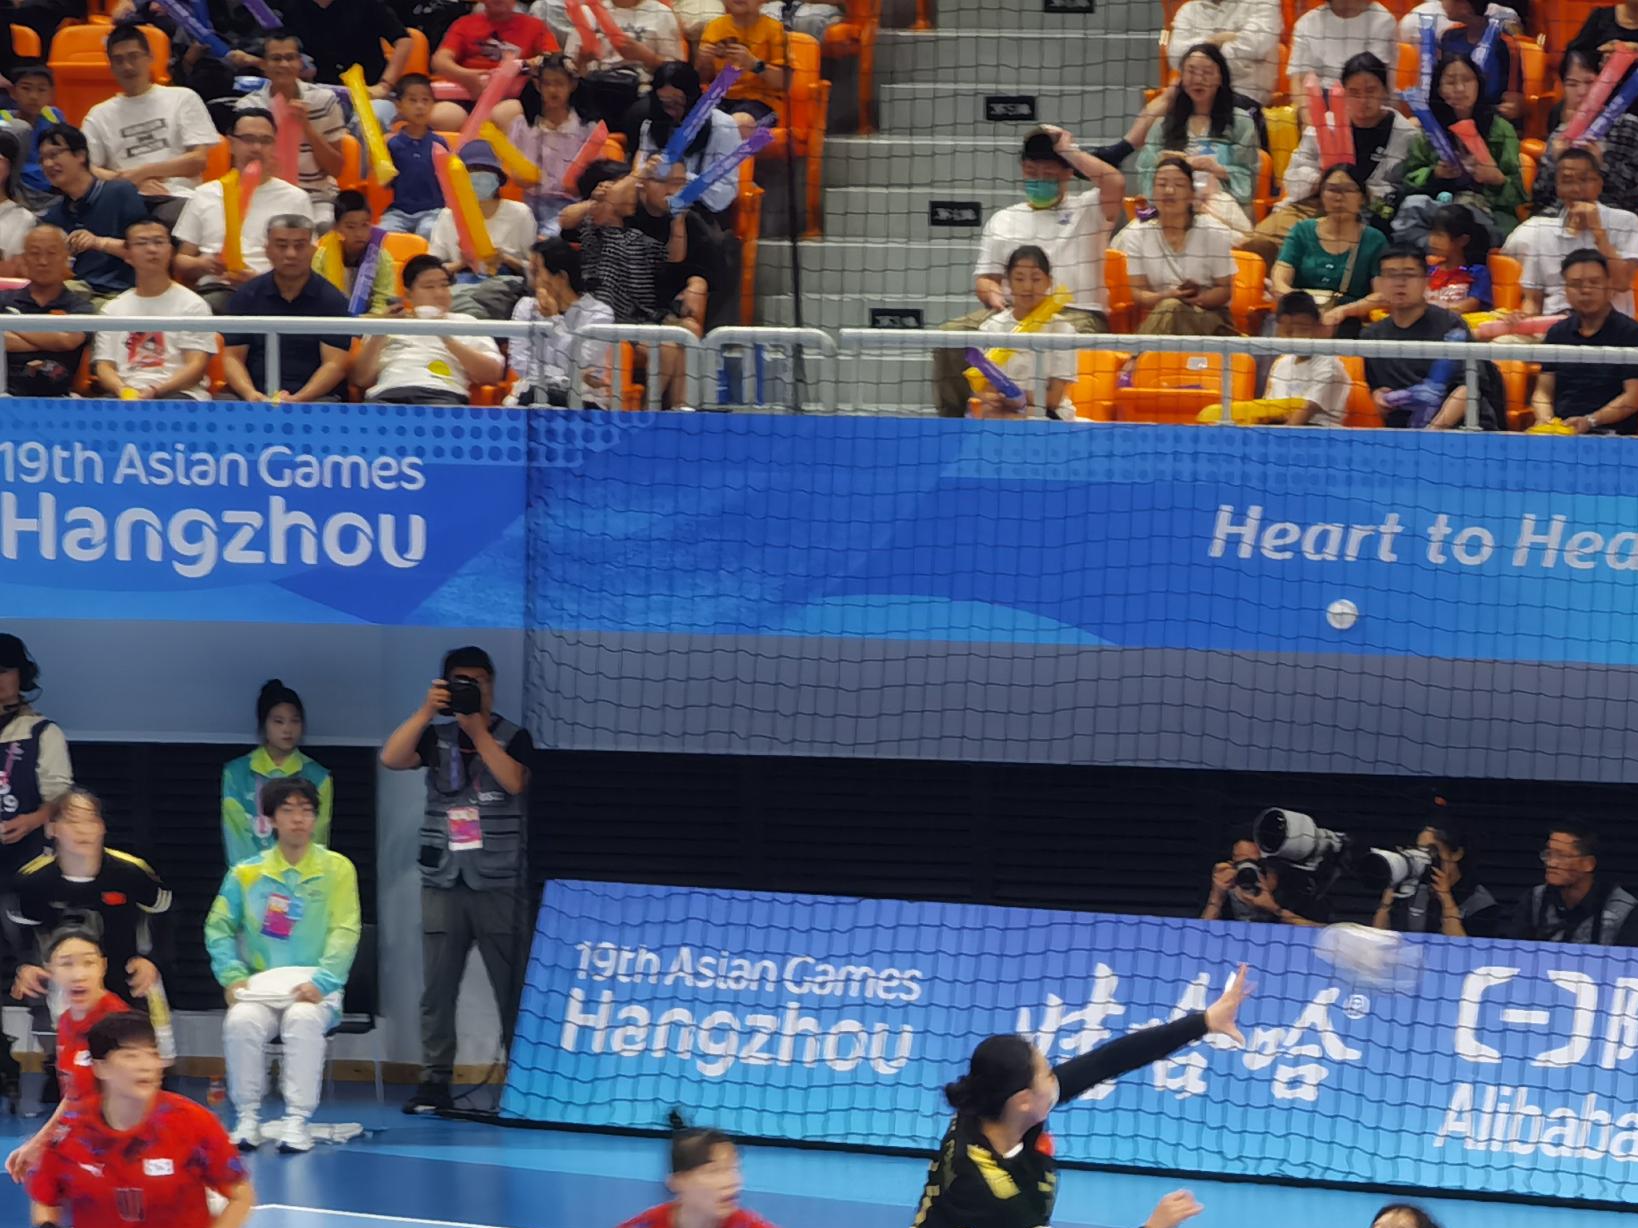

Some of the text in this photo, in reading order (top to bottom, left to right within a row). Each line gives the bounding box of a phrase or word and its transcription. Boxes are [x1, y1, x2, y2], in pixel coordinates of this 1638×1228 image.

[0, 441, 427, 492] 19th Asian Games
[0, 491, 428, 579] Hangzhou
[1208, 503, 1404, 563] Heart
[1426, 513, 1496, 566] to
[574, 940, 925, 1002] 19th Asian Games
[560, 986, 914, 1078] Hangzhou
